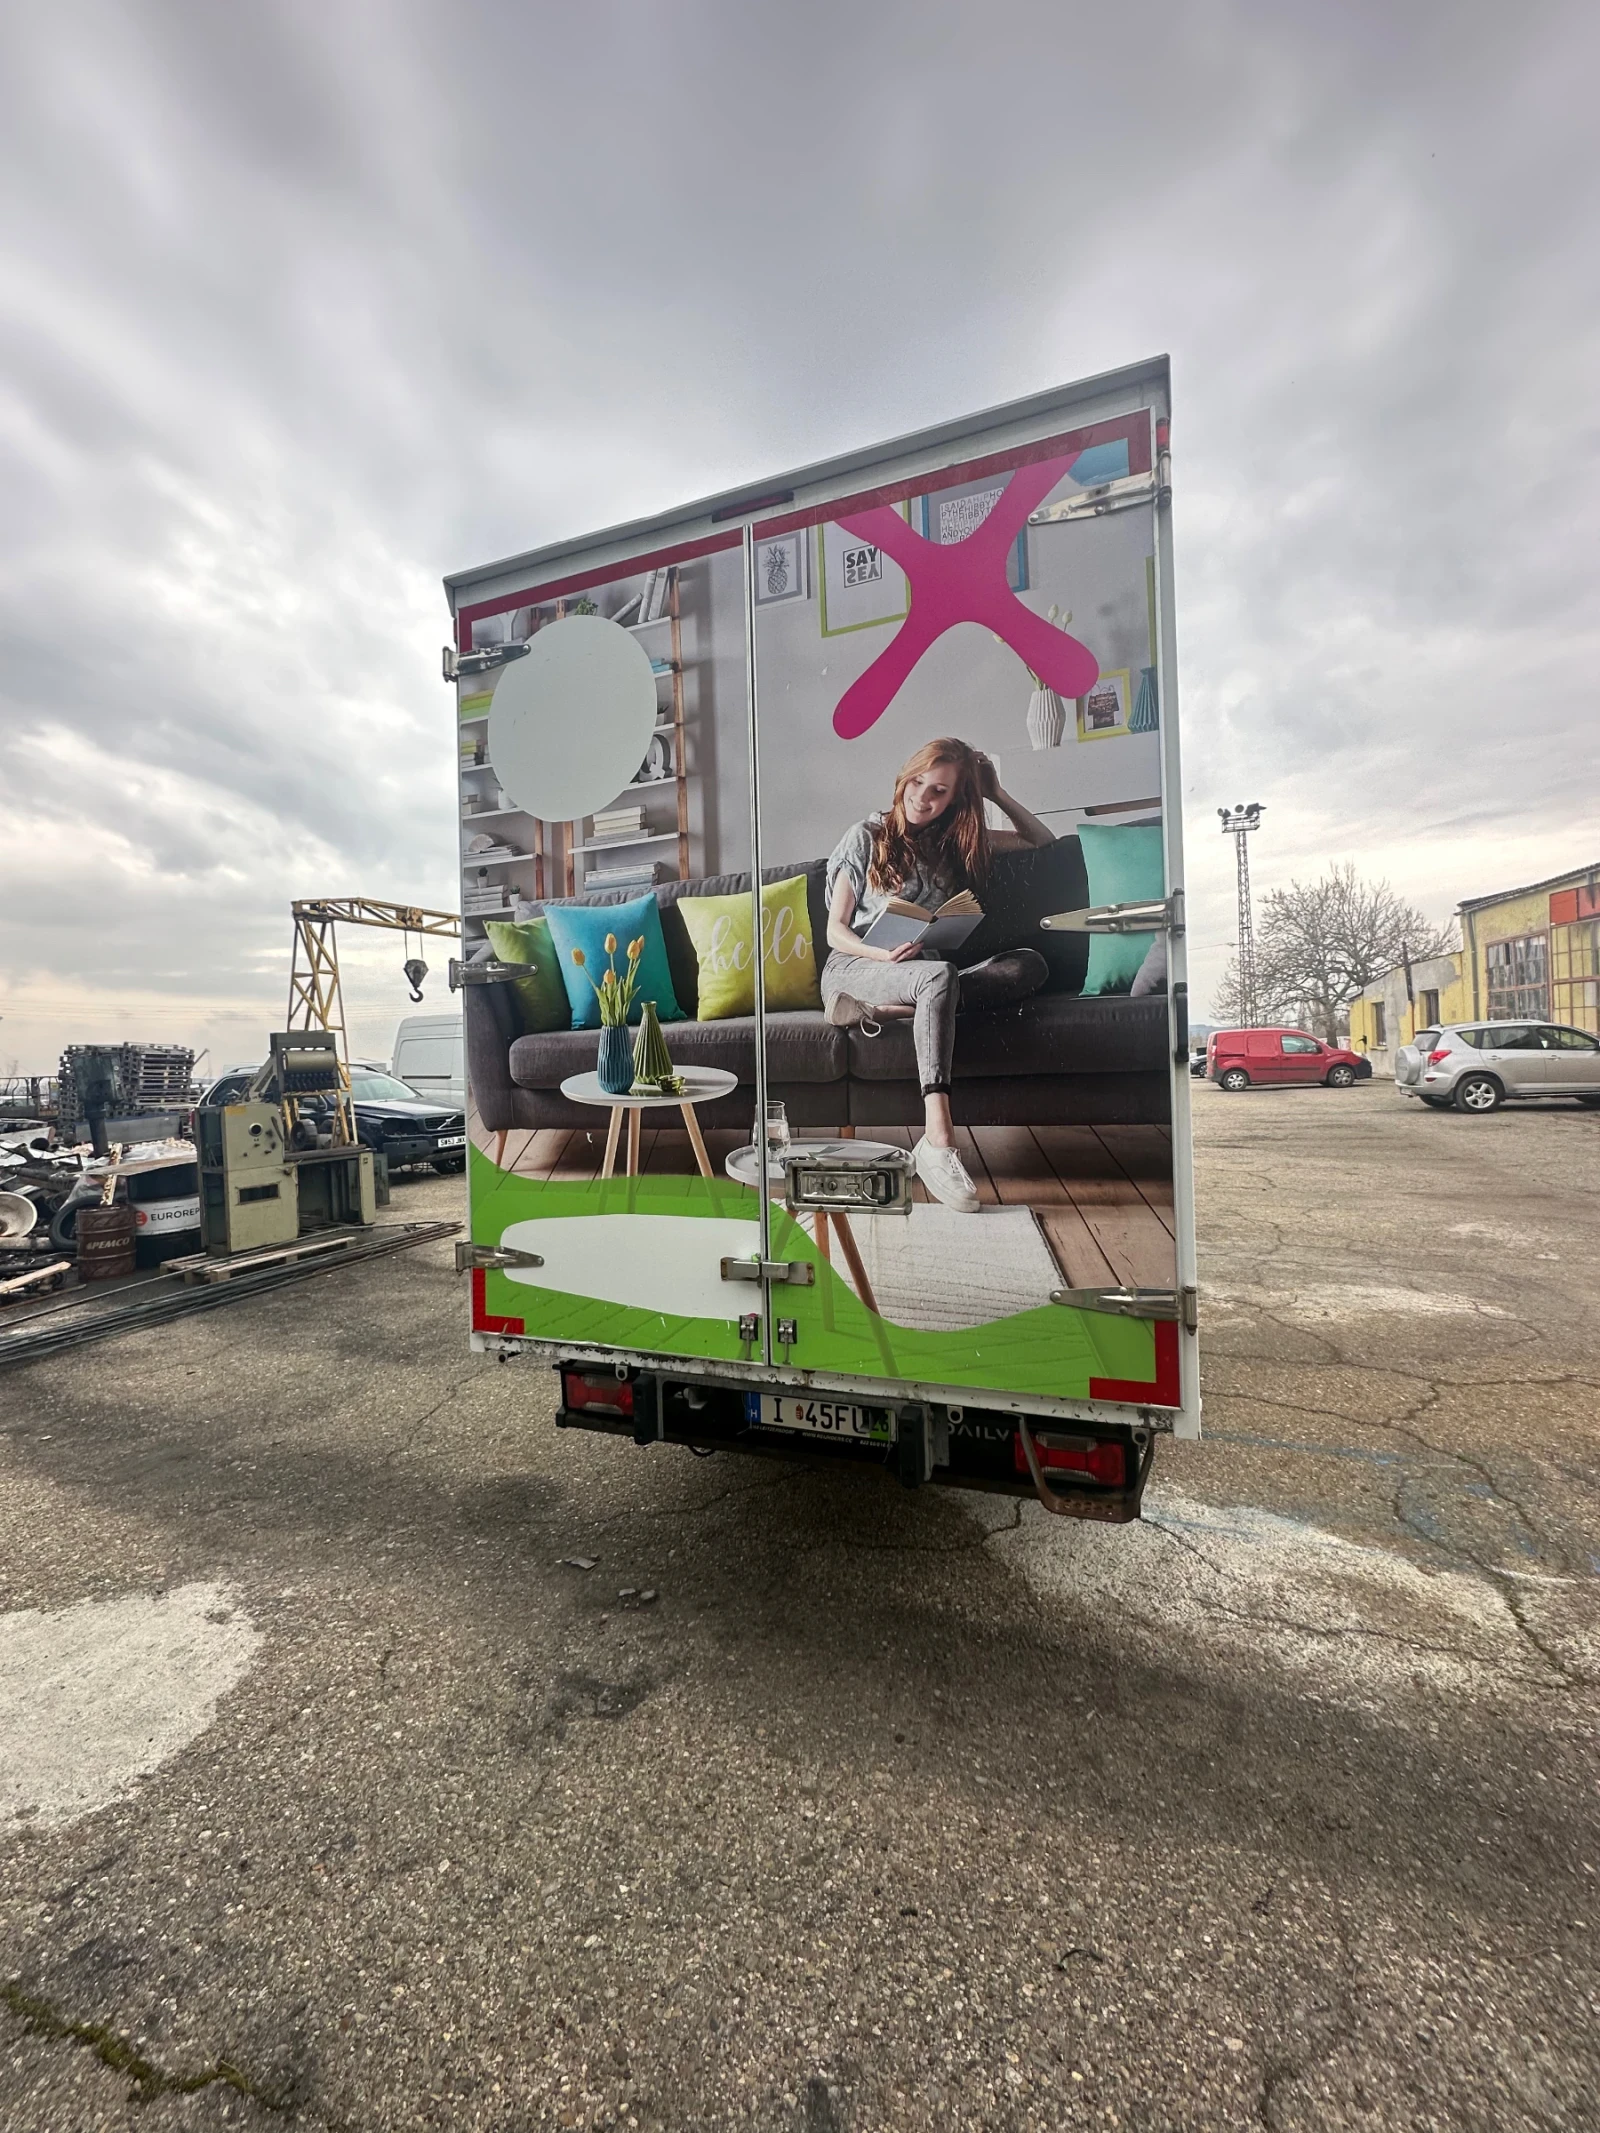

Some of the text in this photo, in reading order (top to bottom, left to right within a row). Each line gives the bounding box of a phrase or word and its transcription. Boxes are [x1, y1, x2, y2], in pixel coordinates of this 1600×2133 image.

[846, 547, 878, 569] SAY
[150, 1207, 200, 1222] EUROREP
[92, 1237, 130, 1250] PEMCO
[750, 1409, 758, 1419] H
[773, 1397, 784, 1423] I
